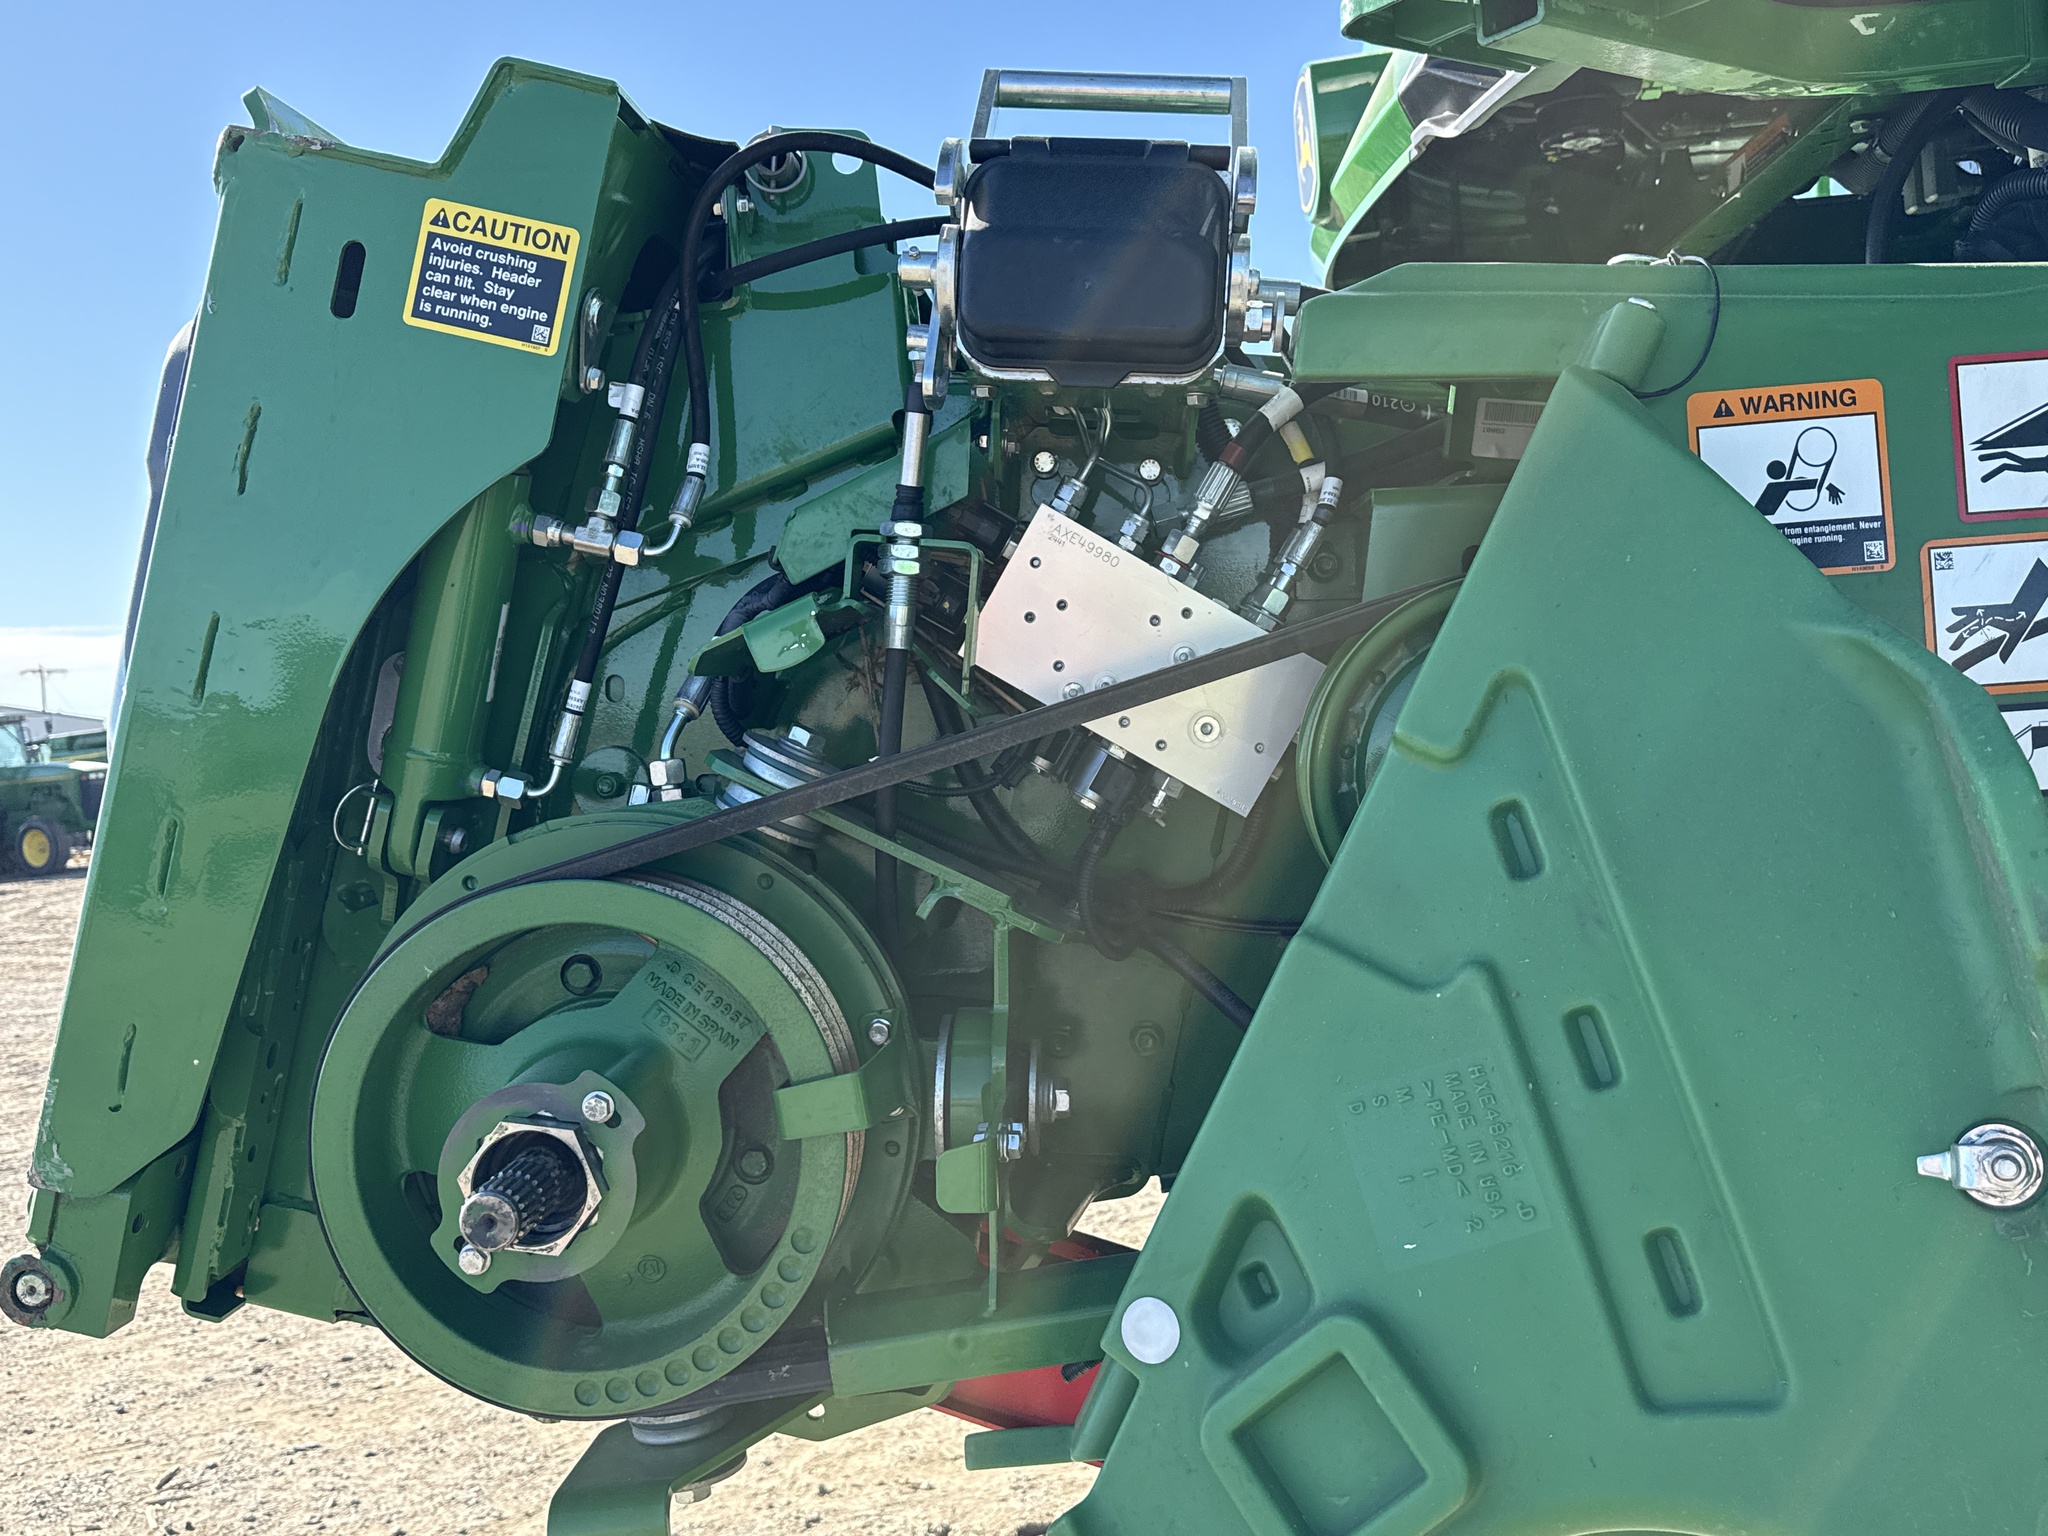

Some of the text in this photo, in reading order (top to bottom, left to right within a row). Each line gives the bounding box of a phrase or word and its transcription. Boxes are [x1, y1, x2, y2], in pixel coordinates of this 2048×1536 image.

[453, 211, 571, 255] CAUTION
[432, 238, 537, 274] Avoid crushing
[428, 253, 542, 288] injuries. Header
[425, 271, 515, 301] can tilt. Stay
[419, 299, 493, 328] is running.
[422, 285, 548, 322] clear when engine
[660, 329, 672, 349] 857
[645, 391, 656, 407] DN
[1372, 394, 1400, 409] 210
[1740, 387, 1857, 415] WARNING
[643, 411, 652, 420] 6
[632, 437, 645, 466] MSHA
[1048, 534, 1065, 547] 2441
[1785, 527, 1801, 535] from
[1804, 522, 1857, 534] entanglement.
[1860, 521, 1881, 529] Never
[1814, 534, 1845, 543] running.
[1052, 524, 1120, 568] AXE49980
[644, 971, 740, 1051] MADE IN SPAIN
[1348, 1101, 1365, 1115] D
[1372, 1095, 1388, 1108] S
[1395, 1086, 1415, 1104] M
[1467, 1064, 1520, 1177] HXE48216
[1444, 1071, 1507, 1219] MADE IN USA
[1466, 1217, 1484, 1234] 2
